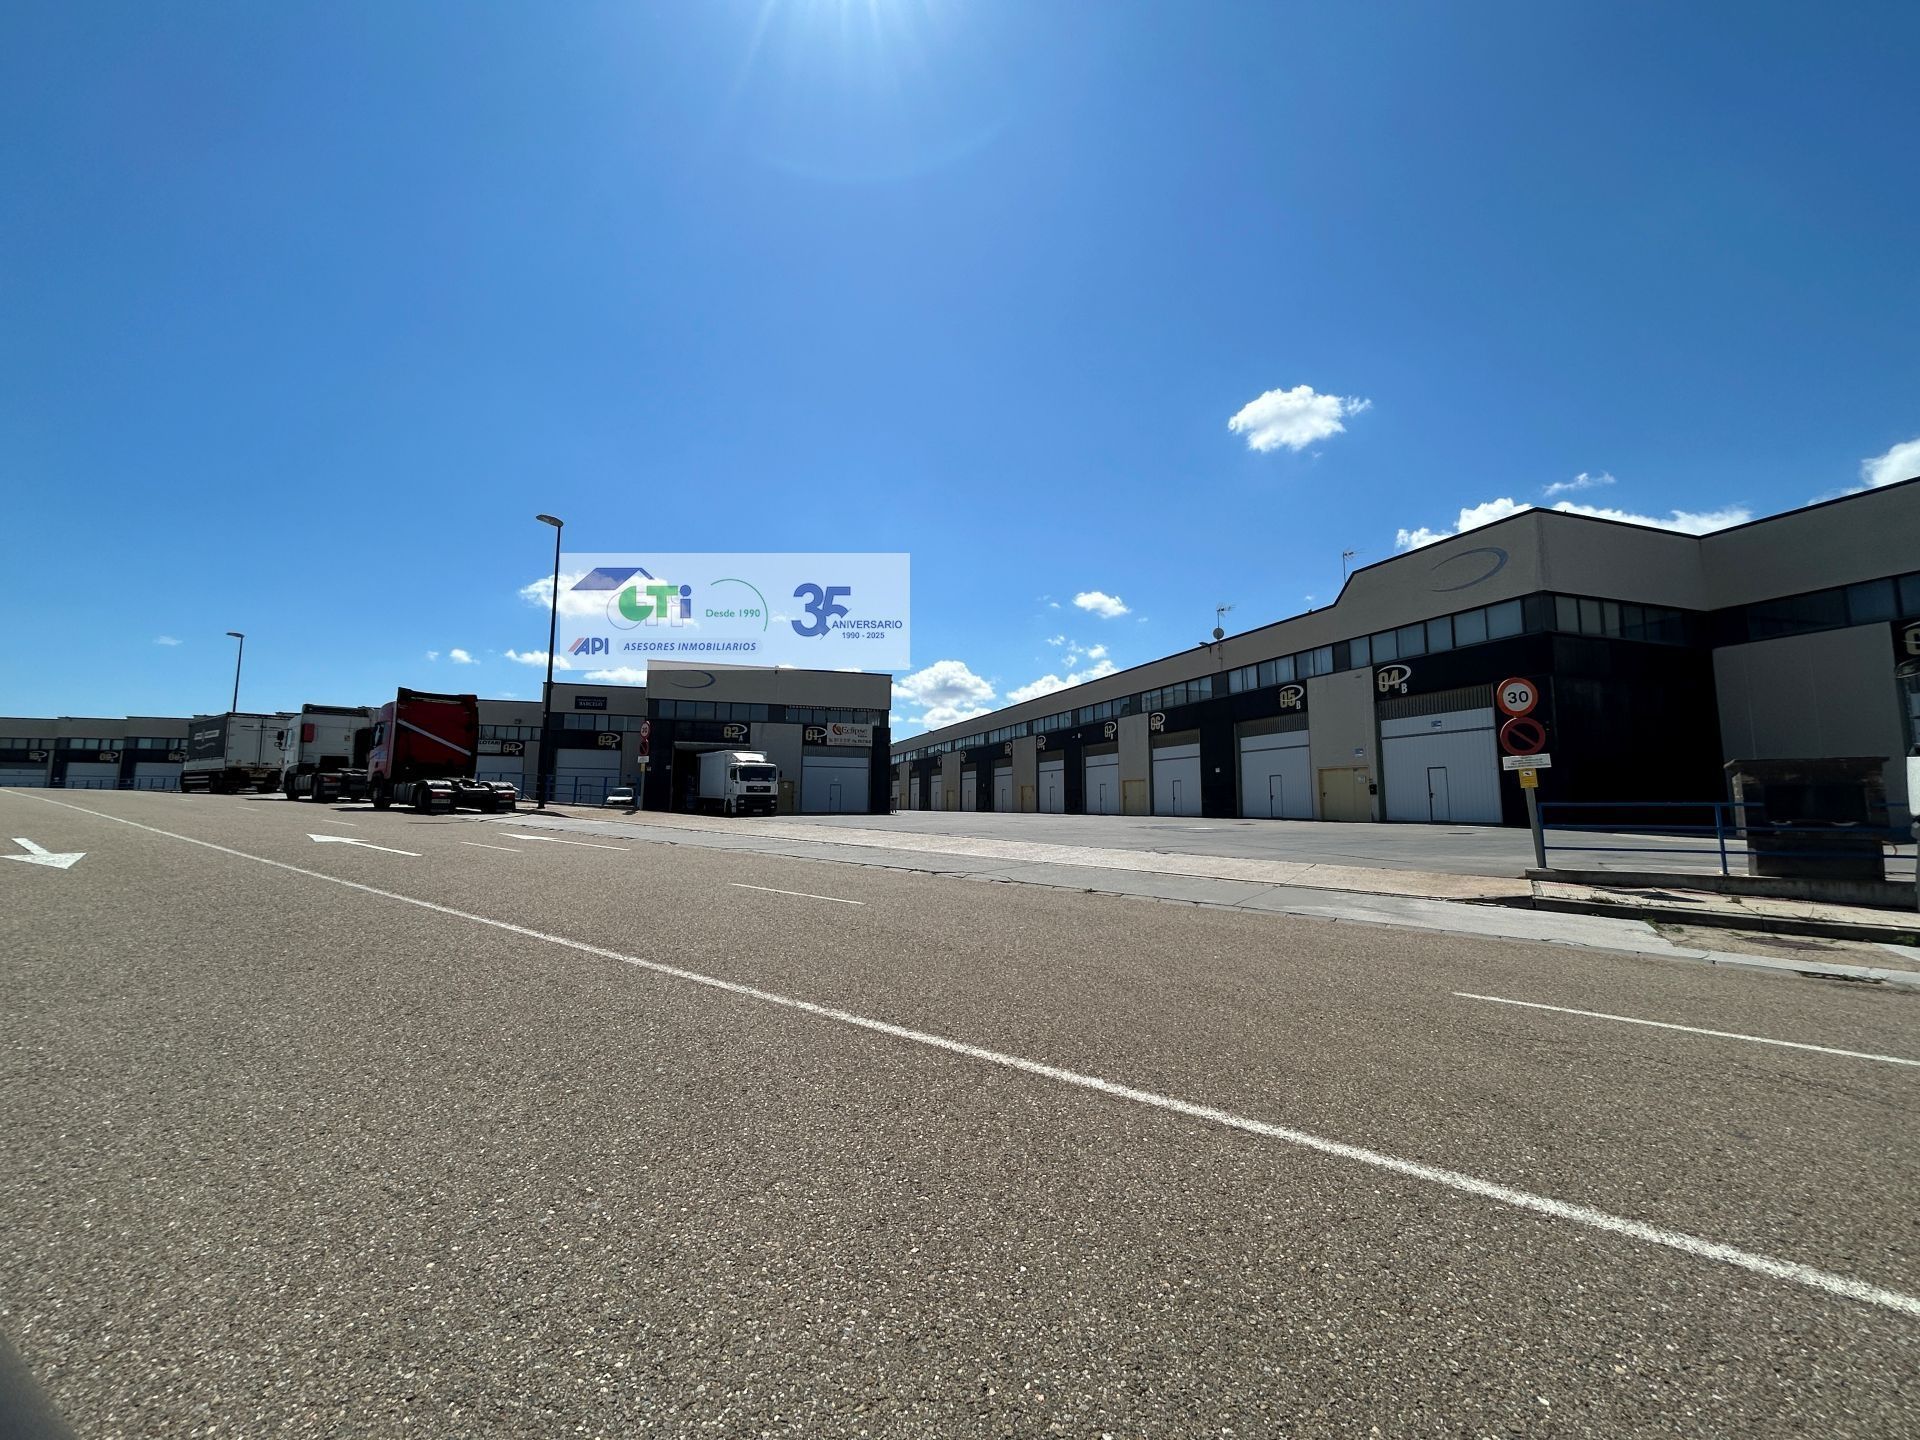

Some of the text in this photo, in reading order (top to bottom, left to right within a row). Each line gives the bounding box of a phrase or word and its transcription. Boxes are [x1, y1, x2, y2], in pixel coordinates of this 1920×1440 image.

[1378, 669, 1408, 694] 04 B
[1279, 689, 1296, 709] 05
[1507, 691, 1529, 704] 30
[723, 726, 739, 738] 02
[805, 729, 818, 741] 01
[597, 735, 613, 746] 03
